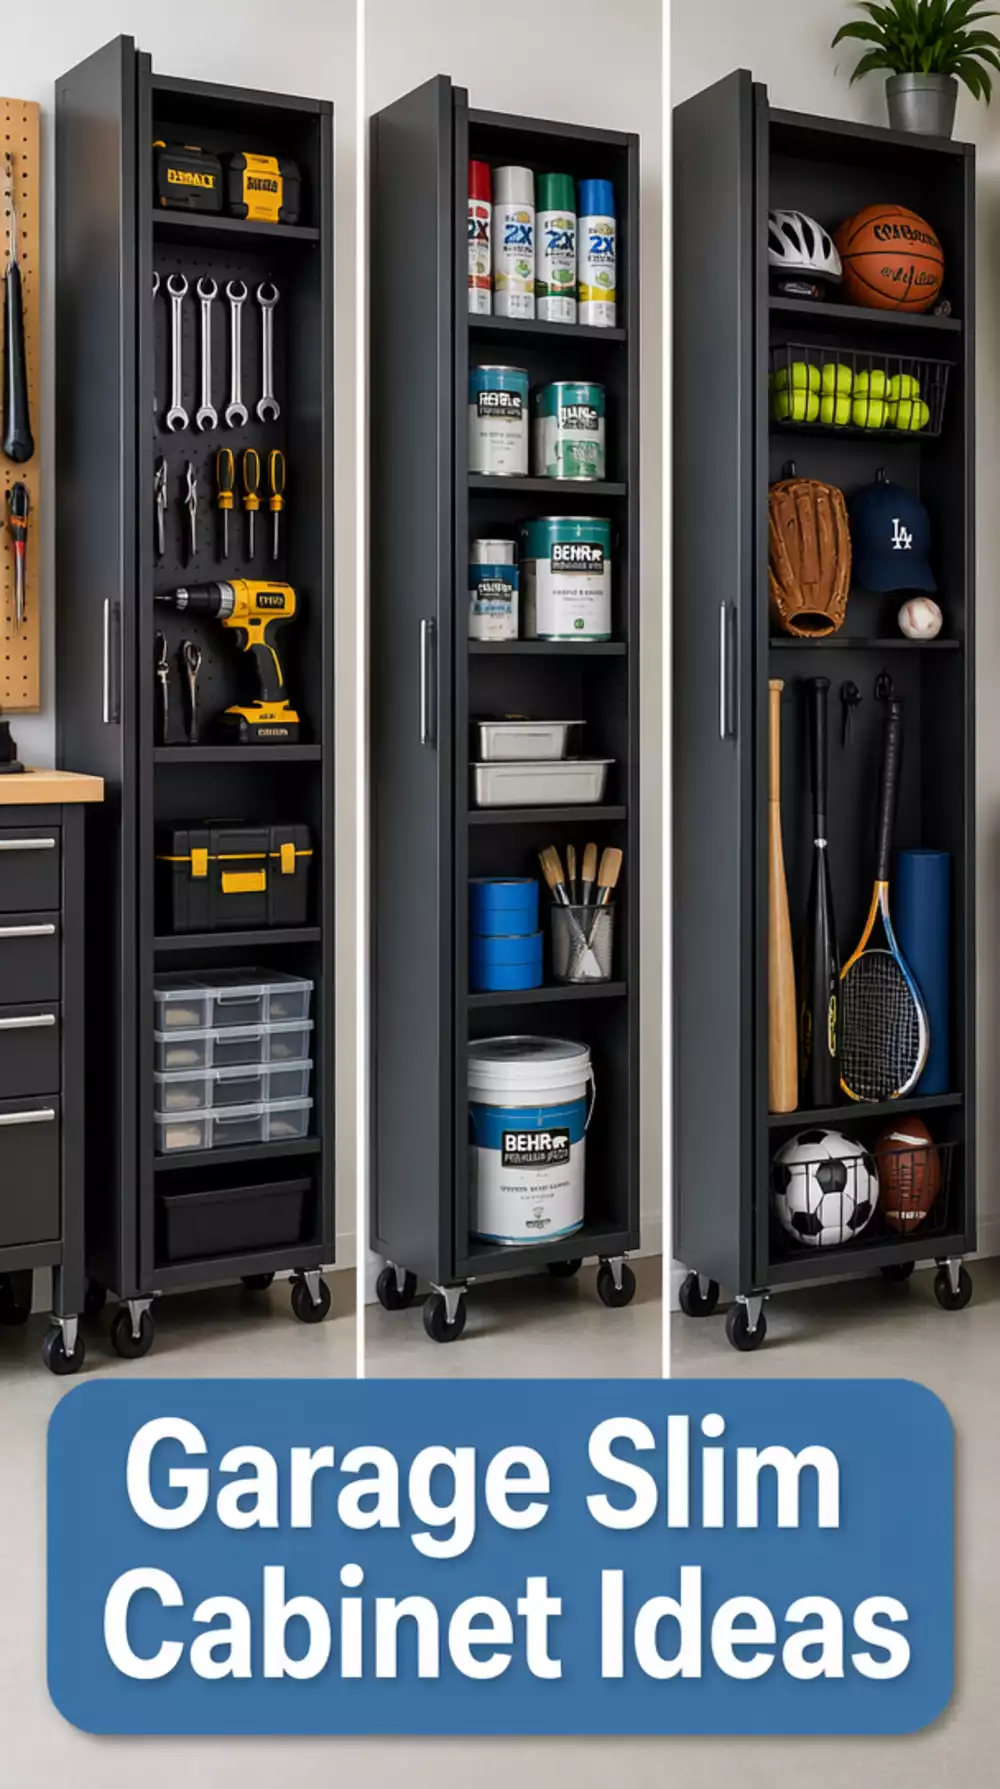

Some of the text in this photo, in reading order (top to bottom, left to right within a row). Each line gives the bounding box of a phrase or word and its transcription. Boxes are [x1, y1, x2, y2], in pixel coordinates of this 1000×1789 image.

[504, 224, 533, 246] 2X
[545, 230, 575, 251] 2X
[589, 235, 615, 256] 2X
[891, 518, 912, 550] LA
[505, 1132, 552, 1152] BEHR
